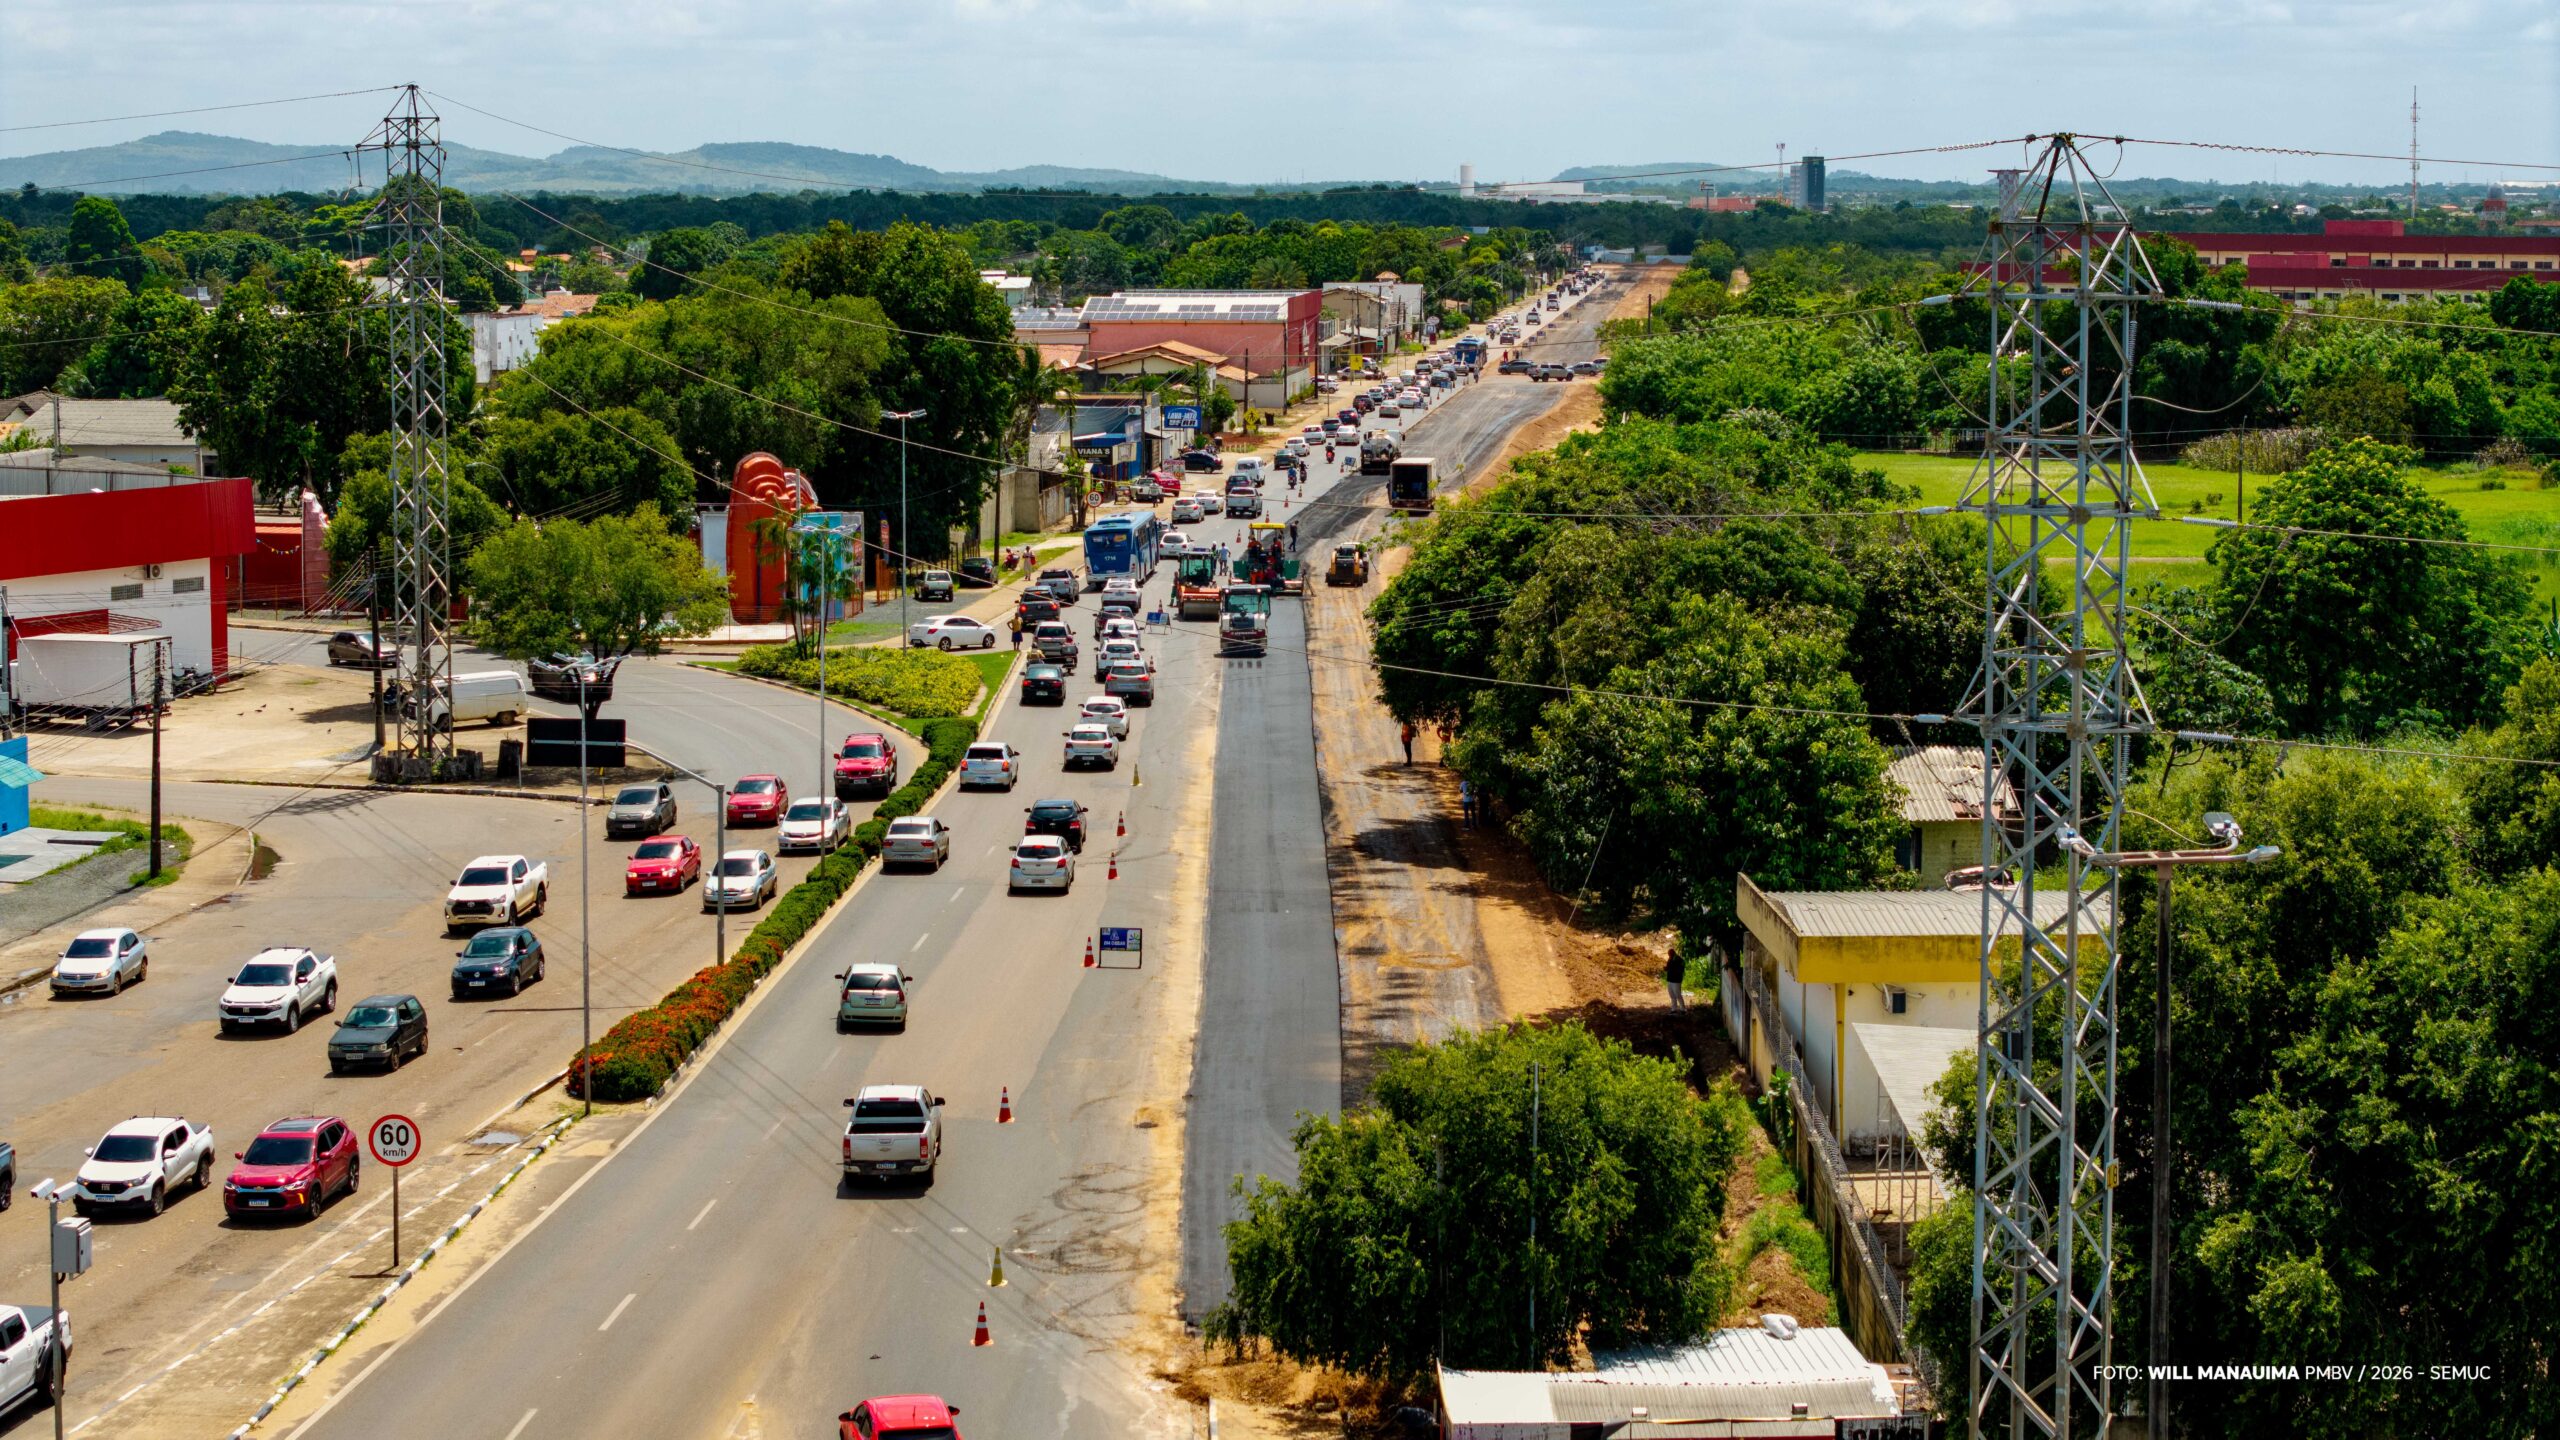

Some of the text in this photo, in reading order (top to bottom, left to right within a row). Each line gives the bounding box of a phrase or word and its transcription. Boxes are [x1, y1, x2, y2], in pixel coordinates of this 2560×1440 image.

[1089, 493, 1100, 501] 60
[380, 1124, 409, 1146] 60
[383, 1148, 407, 1157] km/h
